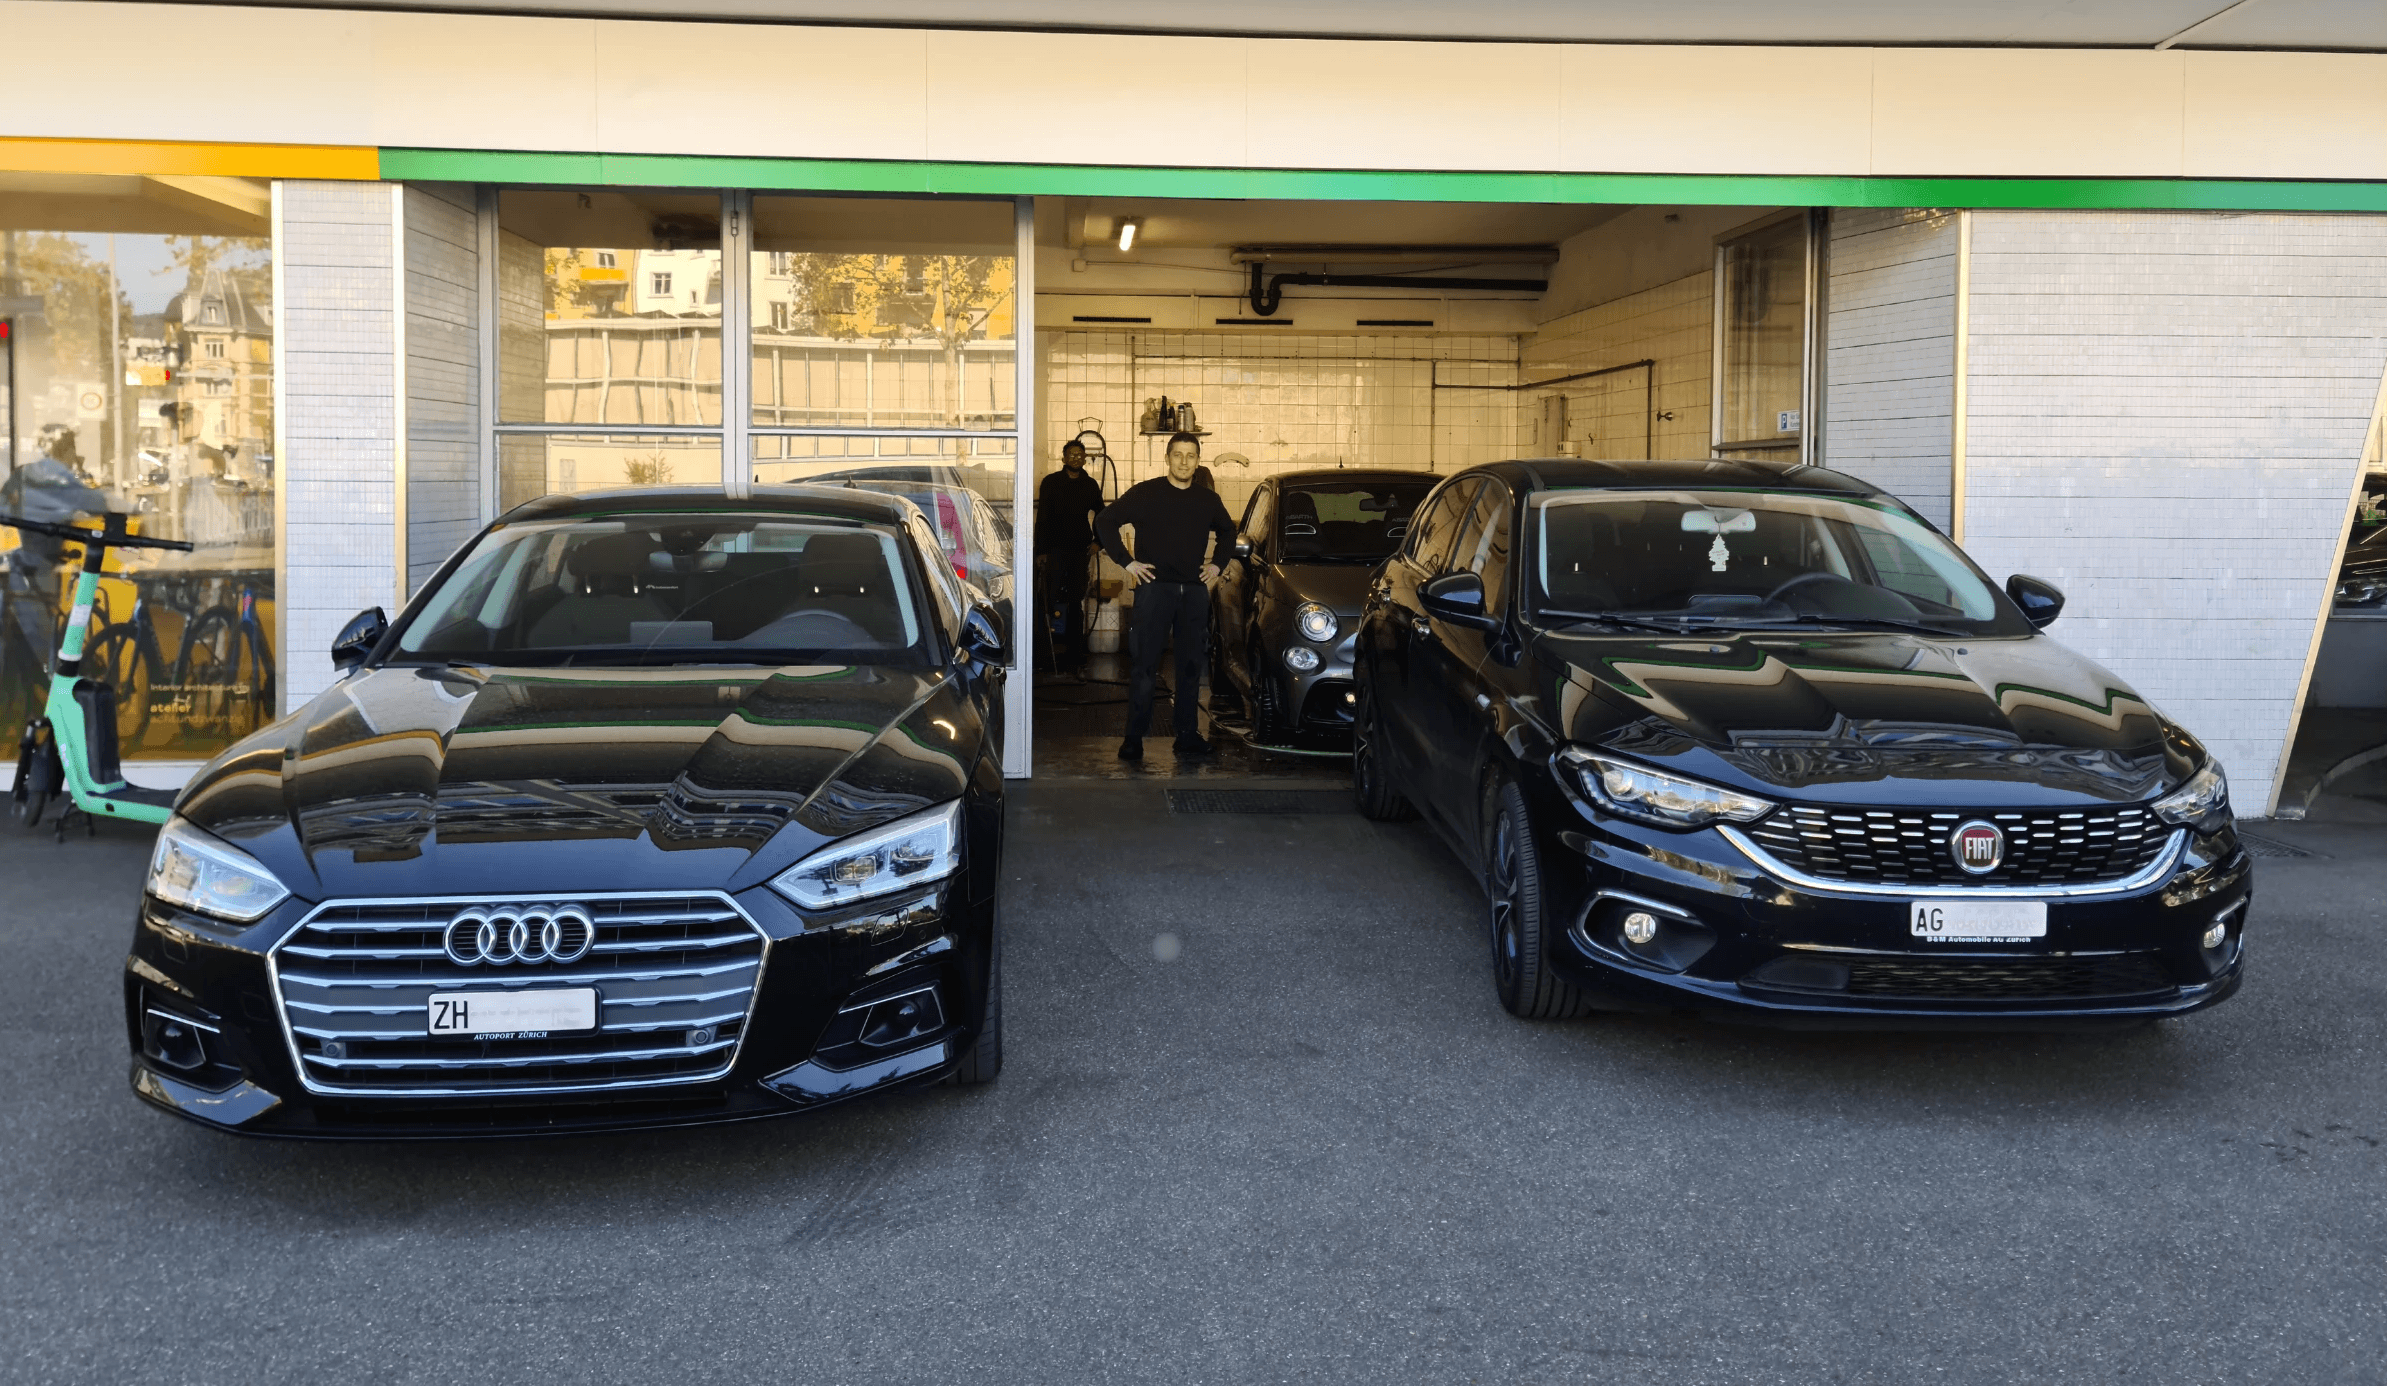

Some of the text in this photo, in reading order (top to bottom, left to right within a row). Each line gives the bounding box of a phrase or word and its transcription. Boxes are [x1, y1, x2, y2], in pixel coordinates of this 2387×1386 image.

[150, 701, 192, 713] atelier
[1965, 837, 1995, 860] FIAT
[1916, 908, 1944, 932] AG
[433, 1000, 468, 1030] ZH
[473, 1030, 547, 1041] AUTOPORT ZÜRICH
